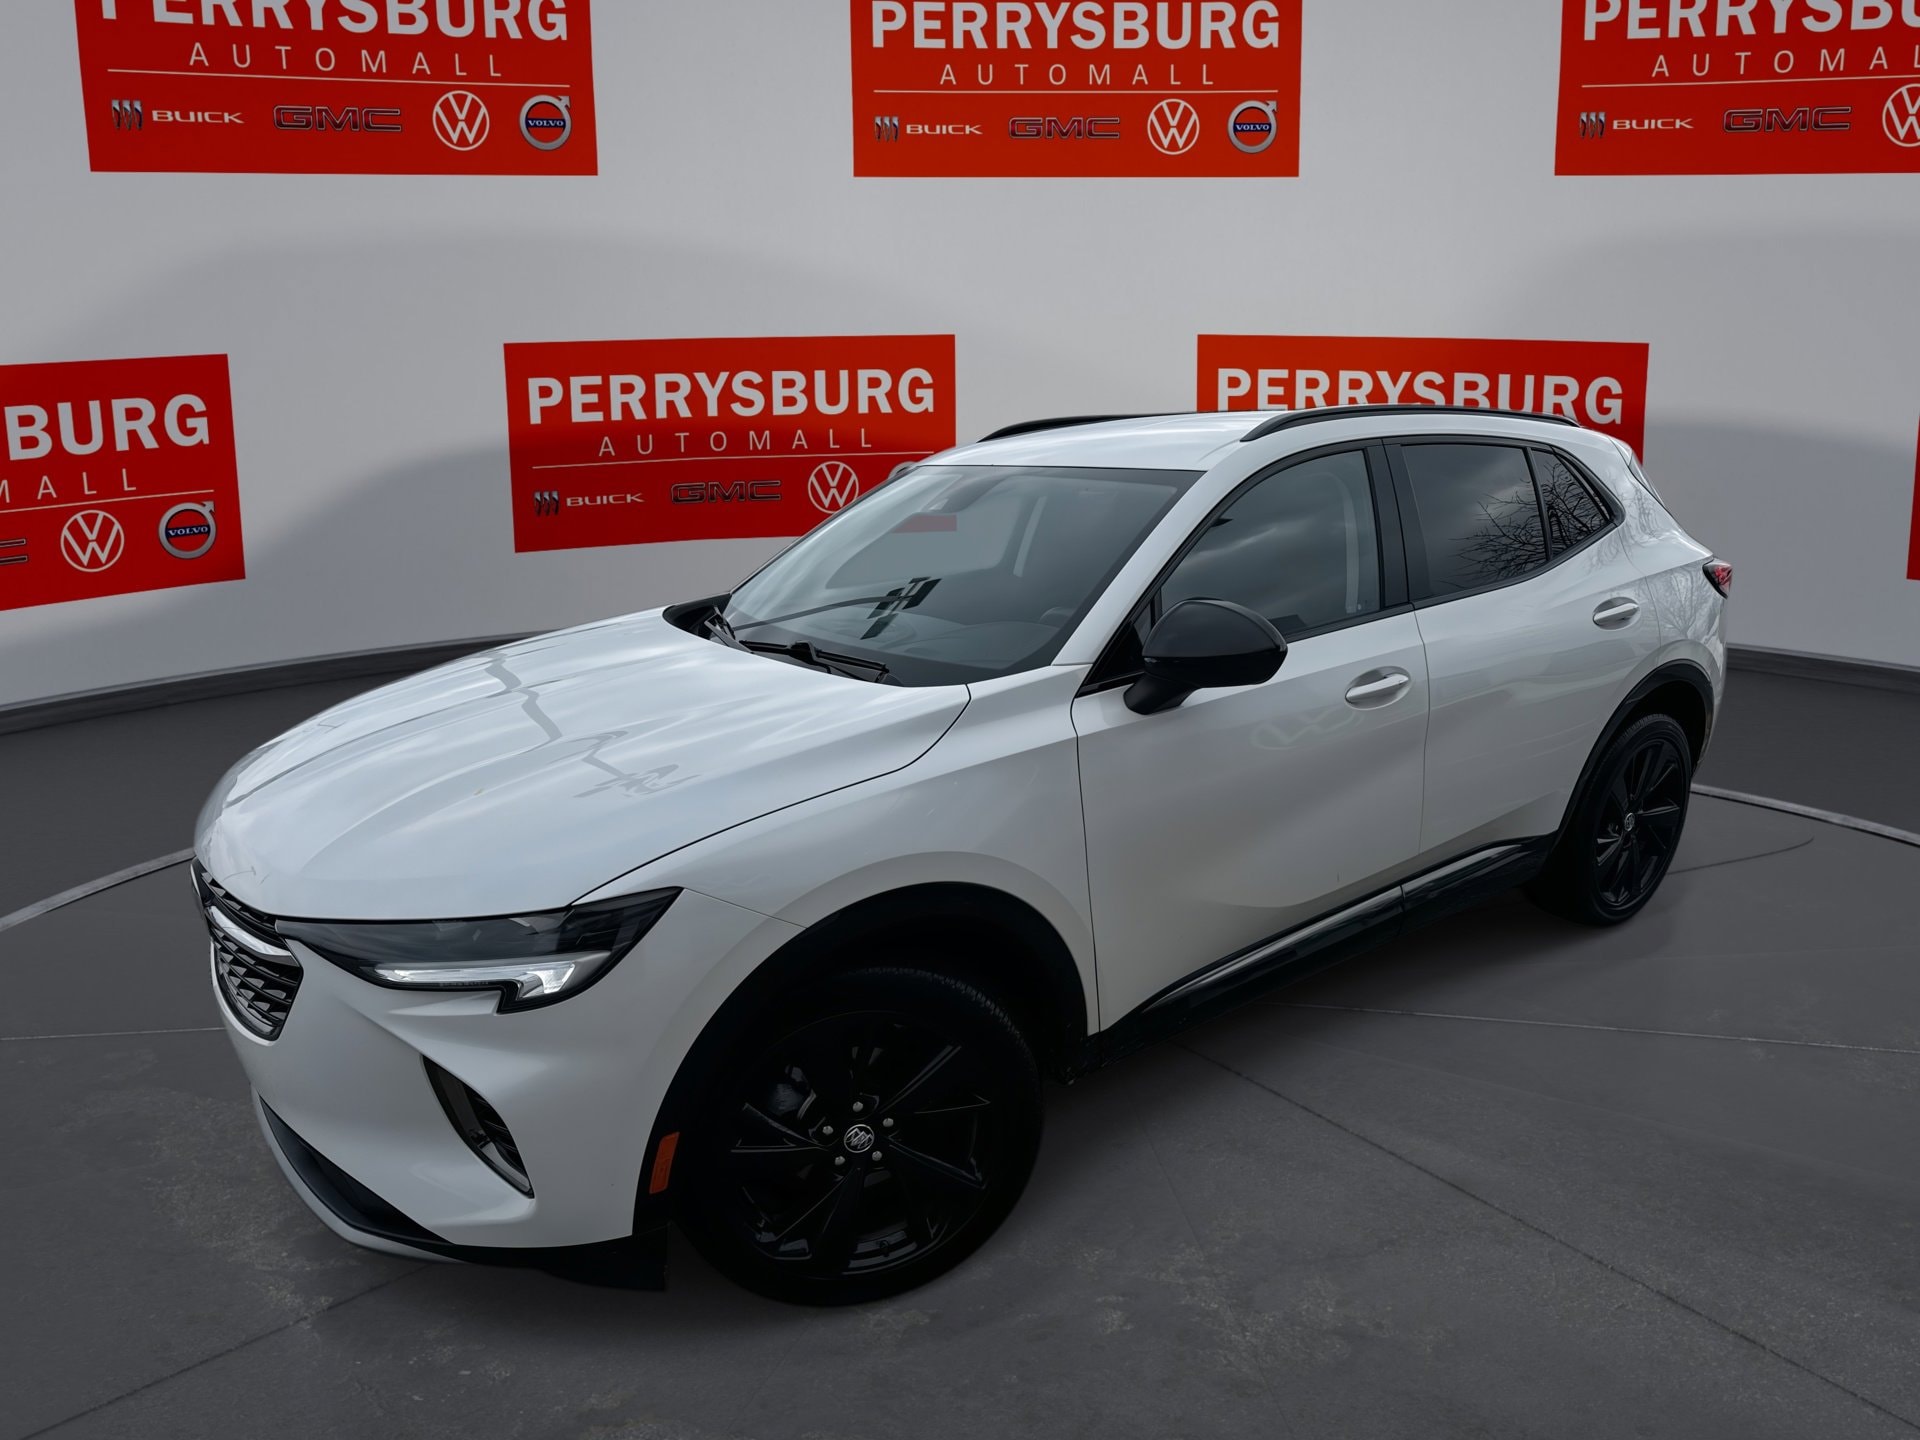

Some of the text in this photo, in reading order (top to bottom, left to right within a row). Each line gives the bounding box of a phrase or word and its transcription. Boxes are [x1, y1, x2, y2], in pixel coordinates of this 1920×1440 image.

[872, 0, 1279, 49] PERRYSBURG
[1584, 0, 1920, 40] PERRYSB
[189, 42, 501, 76] AUTOMALL
[940, 64, 1213, 85] AUTOMALL
[151, 109, 244, 123] BUICK
[273, 104, 402, 132] GMC
[527, 118, 565, 128] VOLVO
[906, 124, 983, 135] BUICK
[1008, 116, 1120, 140] GMC
[1235, 123, 1270, 132] VOLVO
[1612, 118, 1694, 130] BUICK
[1722, 106, 1852, 133] GMC
[527, 368, 934, 424] PERRYSBURG
[1217, 368, 1624, 424] PERRYSBURG
[598, 428, 872, 457] AUTOMALL
[566, 493, 644, 507] BUICK
[670, 480, 782, 505] GMC
[167, 525, 209, 536] VOLVO
